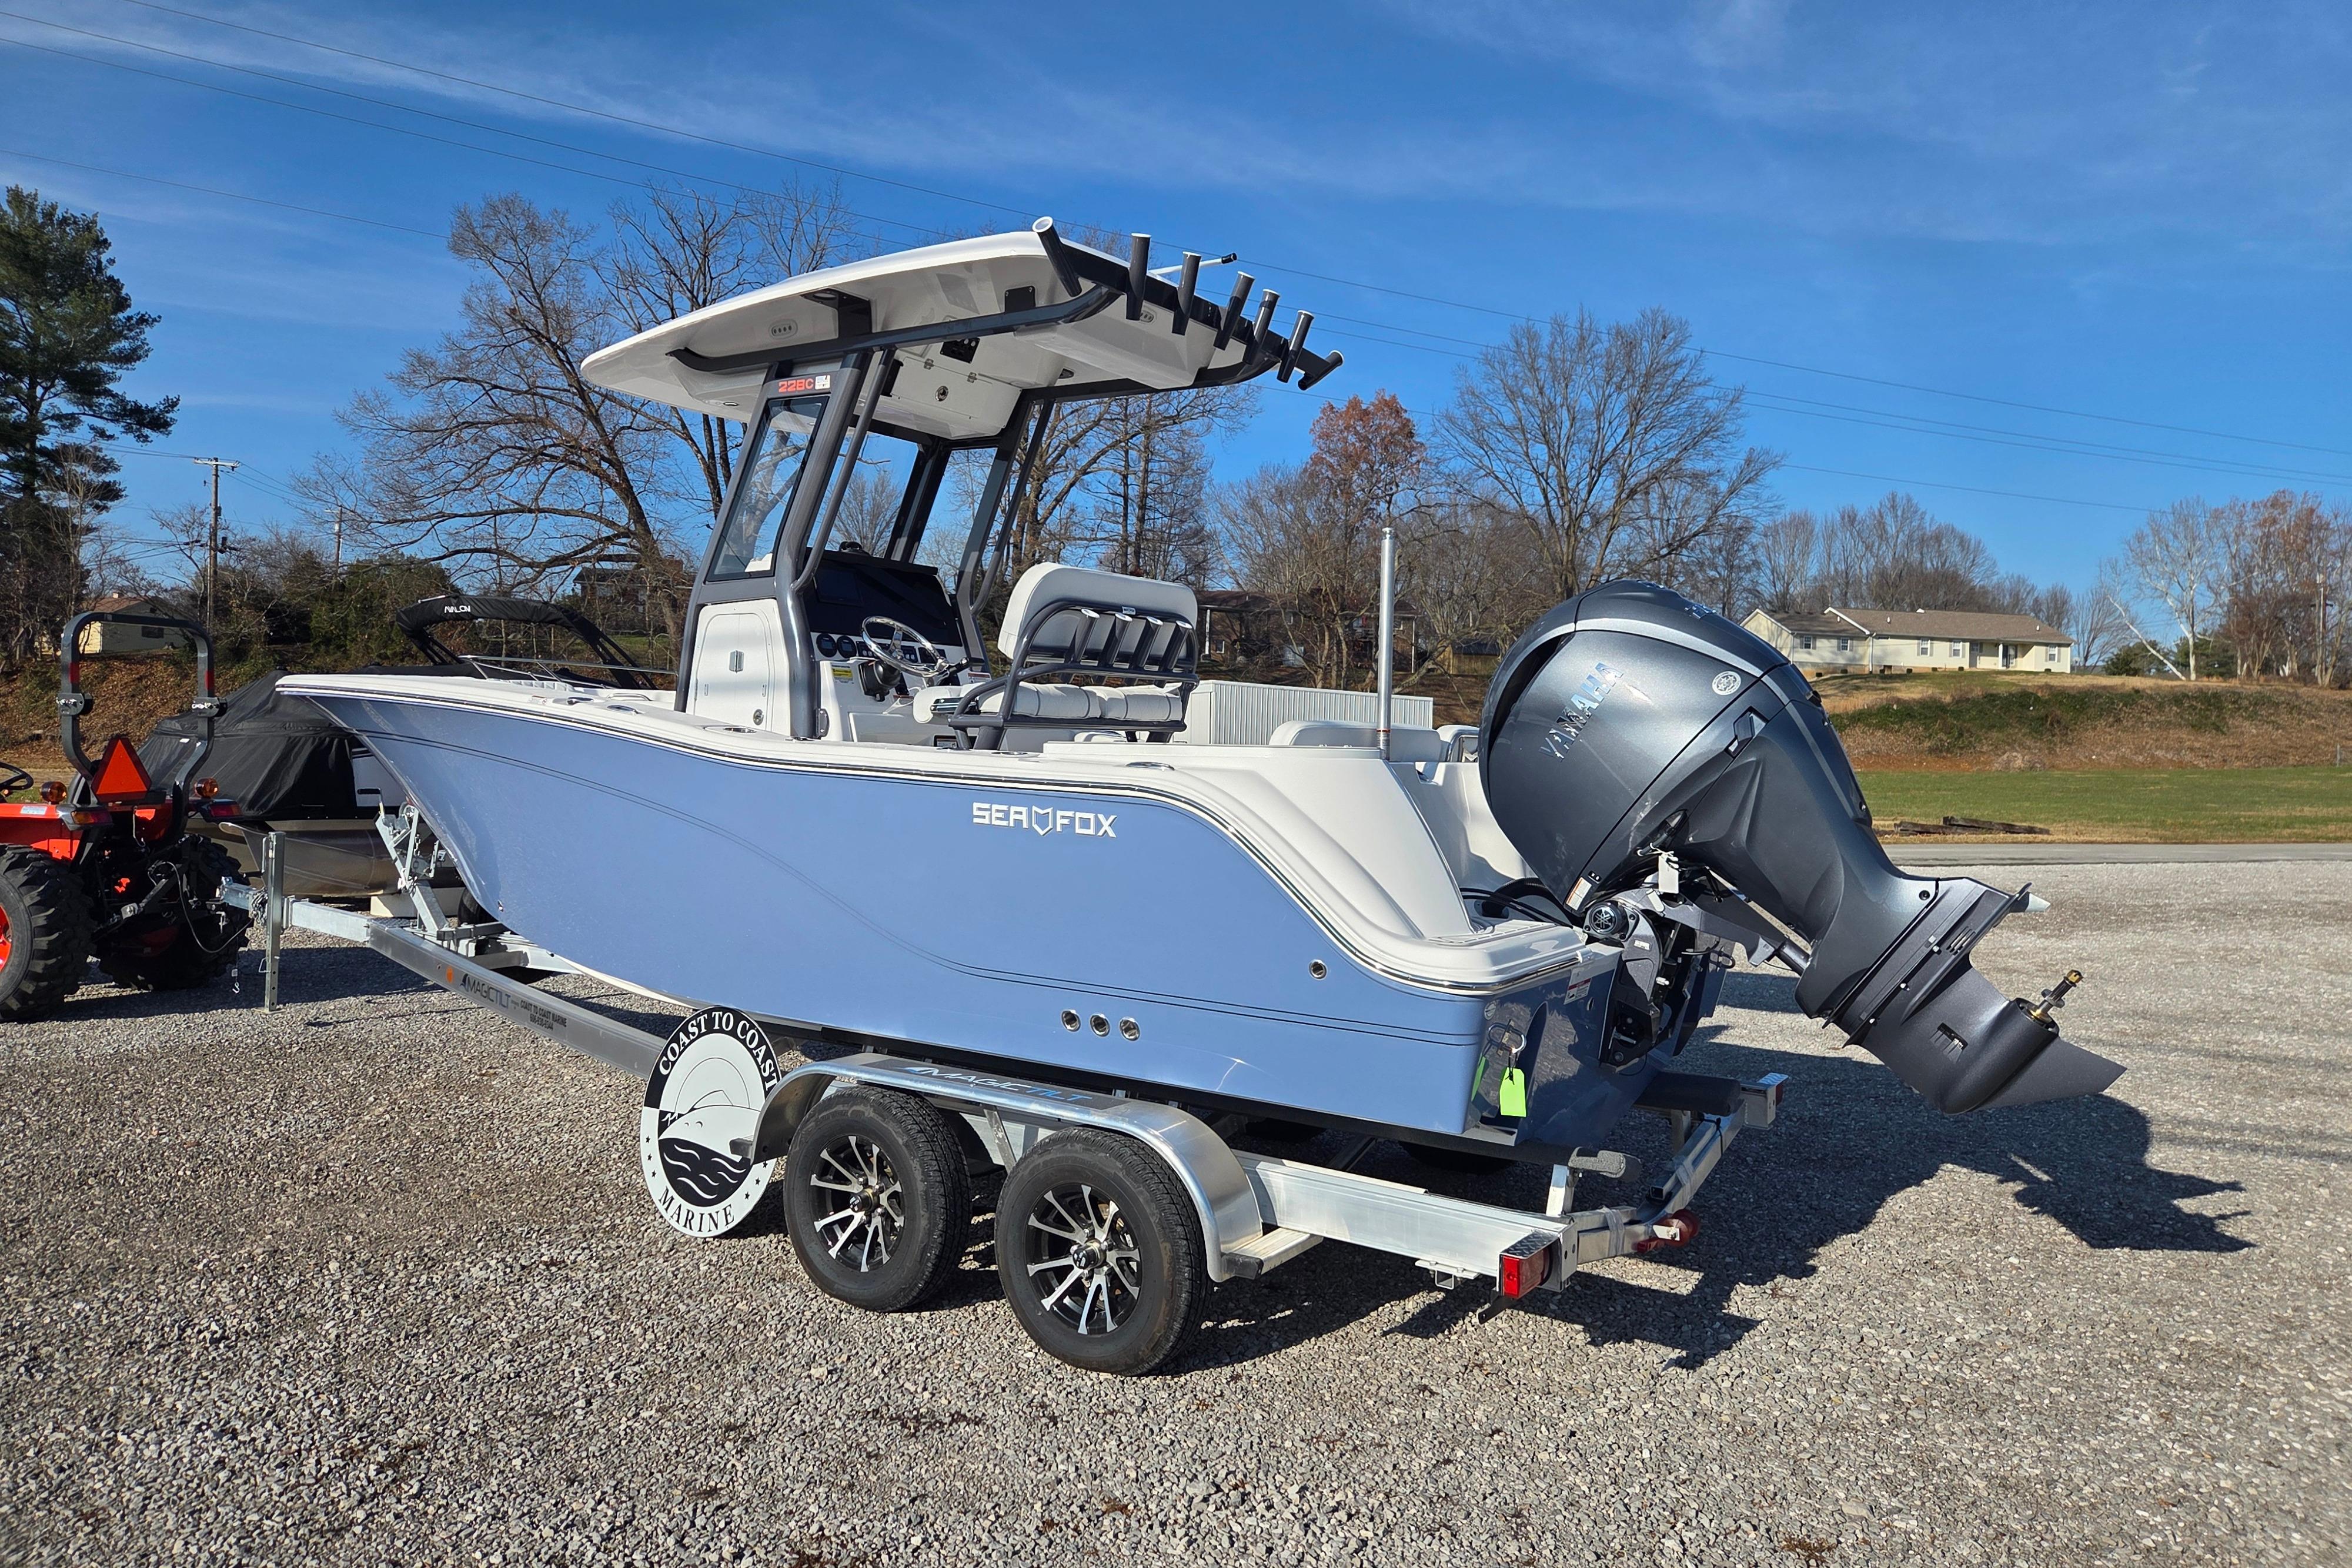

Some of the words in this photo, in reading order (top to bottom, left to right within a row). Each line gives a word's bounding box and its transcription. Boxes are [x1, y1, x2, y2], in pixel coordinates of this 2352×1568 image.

[444, 605, 471, 613] AVALON
[1538, 661, 1625, 763] YAMAHA
[972, 801, 1029, 829] SEA
[1056, 810, 1117, 838] FOX
[659, 1013, 708, 1075] COAST
[711, 1011, 734, 1031] TO
[737, 1019, 778, 1091] COAST
[658, 1185, 736, 1233] MARINE
